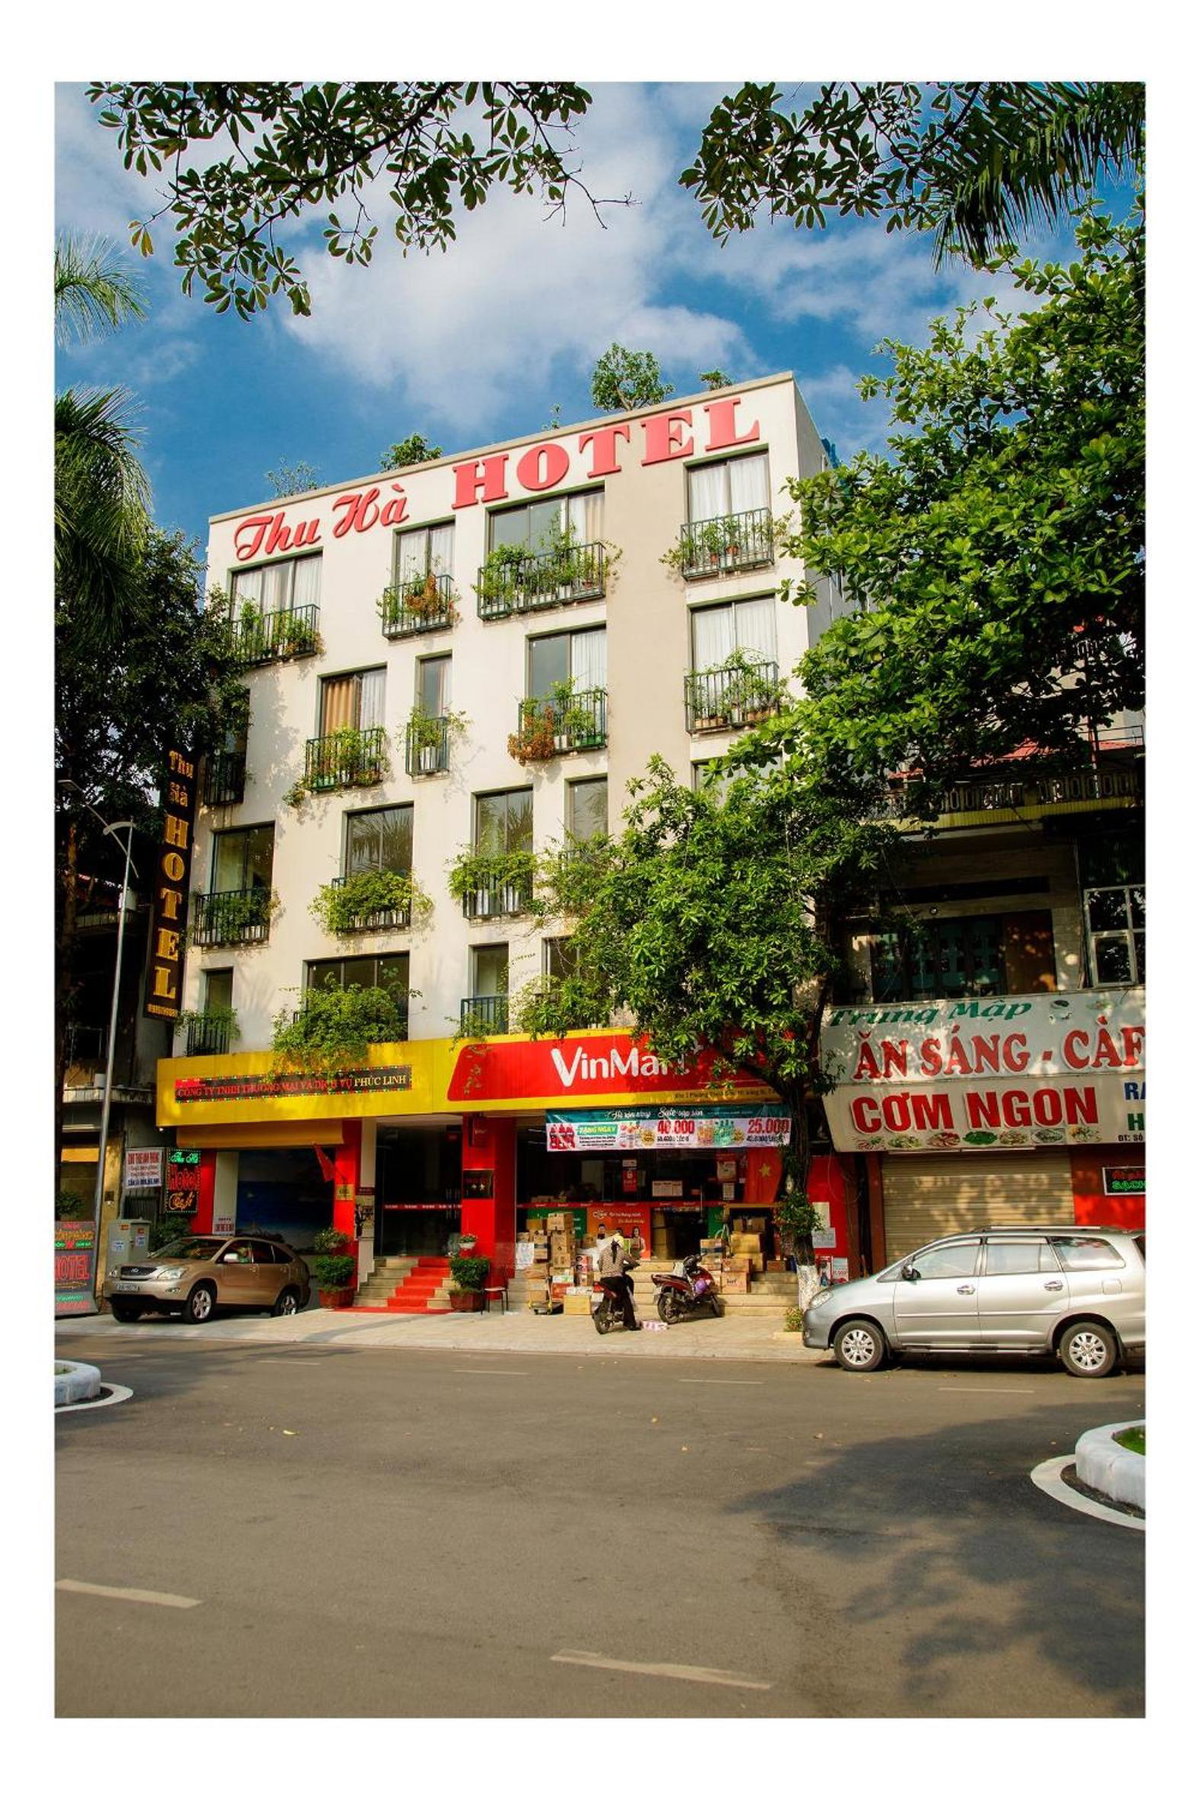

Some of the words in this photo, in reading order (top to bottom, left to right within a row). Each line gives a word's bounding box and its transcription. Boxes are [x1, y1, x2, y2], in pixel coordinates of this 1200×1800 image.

[234, 512, 322, 561] Thu
[332, 483, 410, 538] Hà
[451, 398, 760, 509] HOTEL
[168, 750, 194, 779] Thu
[152, 814, 189, 999] HOTEL
[831, 1008, 938, 1026] Trung
[948, 1000, 1032, 1022] Mập
[853, 1030, 909, 1080] ĂN
[920, 1025, 1031, 1077] SÁNG
[354, 1075, 381, 1087] PHÚC
[383, 1074, 406, 1085] LINH
[852, 1091, 954, 1134] CƠM
[966, 1087, 1099, 1129] NGON
